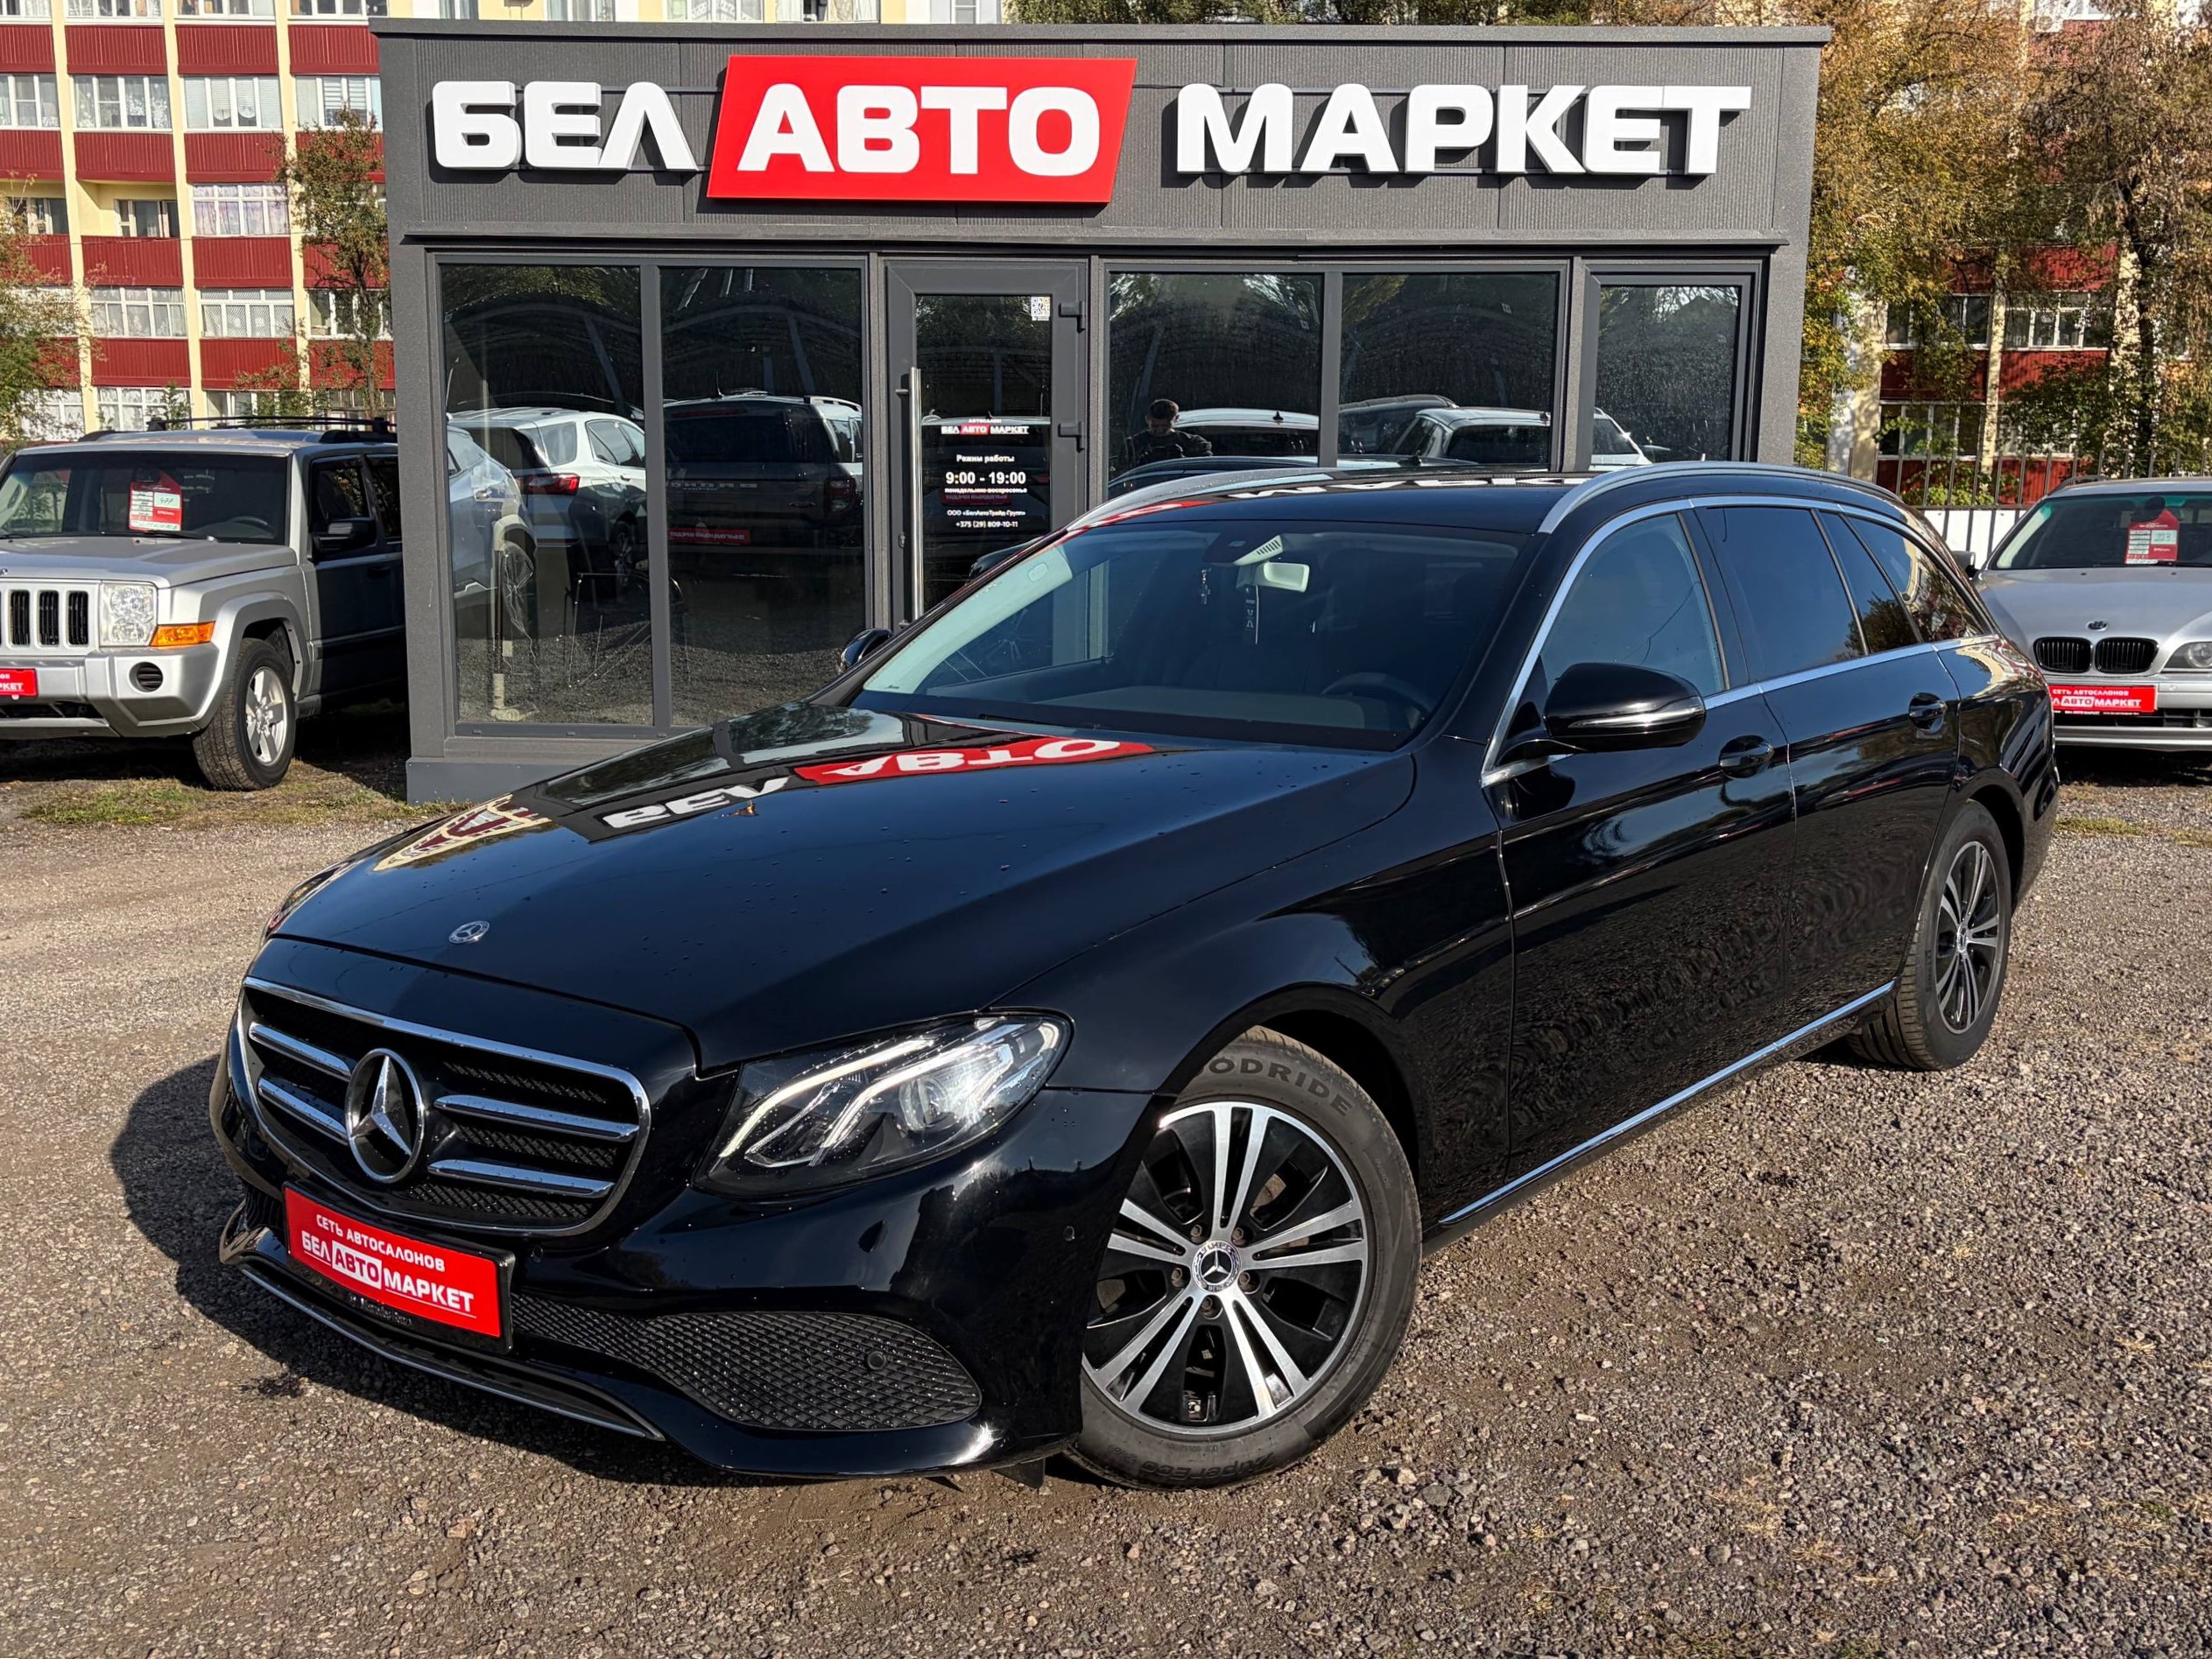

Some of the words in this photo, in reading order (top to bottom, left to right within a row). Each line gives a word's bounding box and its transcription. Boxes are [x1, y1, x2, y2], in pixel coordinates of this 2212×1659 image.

[432, 81, 699, 171] БЕЛ
[737, 83, 1101, 177] АВТО
[1177, 83, 1751, 175] МАРКЕТ
[940, 425, 961, 434] БЕЛ
[990, 425, 1029, 434] МАРКЕТ
[984, 454, 1015, 464] работы
[946, 471, 976, 484] 9:00
[988, 471, 1026, 484] 19:00
[973, 520, 986, 529] (29)
[1197, 1058, 1352, 1117] ODRIDE
[316, 1213, 343, 1237] СЕТЬ
[347, 1228, 445, 1272] АВТОСАЛОНОВ
[301, 1230, 330, 1262] БЕЛ
[335, 1248, 379, 1282] АВТО
[384, 1269, 474, 1312] МАРКЕТ
